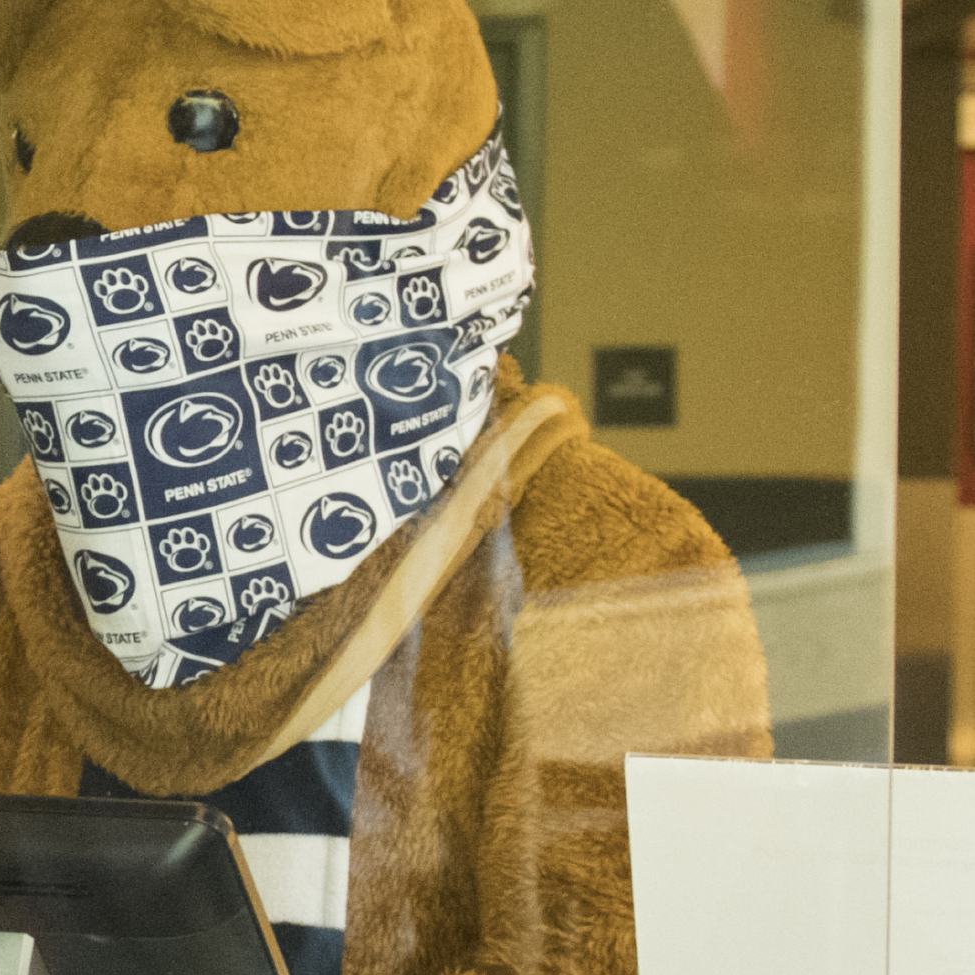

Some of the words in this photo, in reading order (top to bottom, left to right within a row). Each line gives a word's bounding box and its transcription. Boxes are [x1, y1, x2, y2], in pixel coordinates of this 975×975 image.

[352, 210, 389, 225] PENN
[465, 284, 488, 301] PENN
[265, 328, 298, 344] PENN
[298, 322, 333, 336] STATE
[14, 372, 44, 384] PENN
[44, 368, 84, 383] STATE
[390, 414, 421, 436] PENN
[421, 404, 450, 427] STATE
[164, 481, 205, 503] PENN
[206, 468, 248, 493] STATE
[105, 632, 142, 645] STATE
